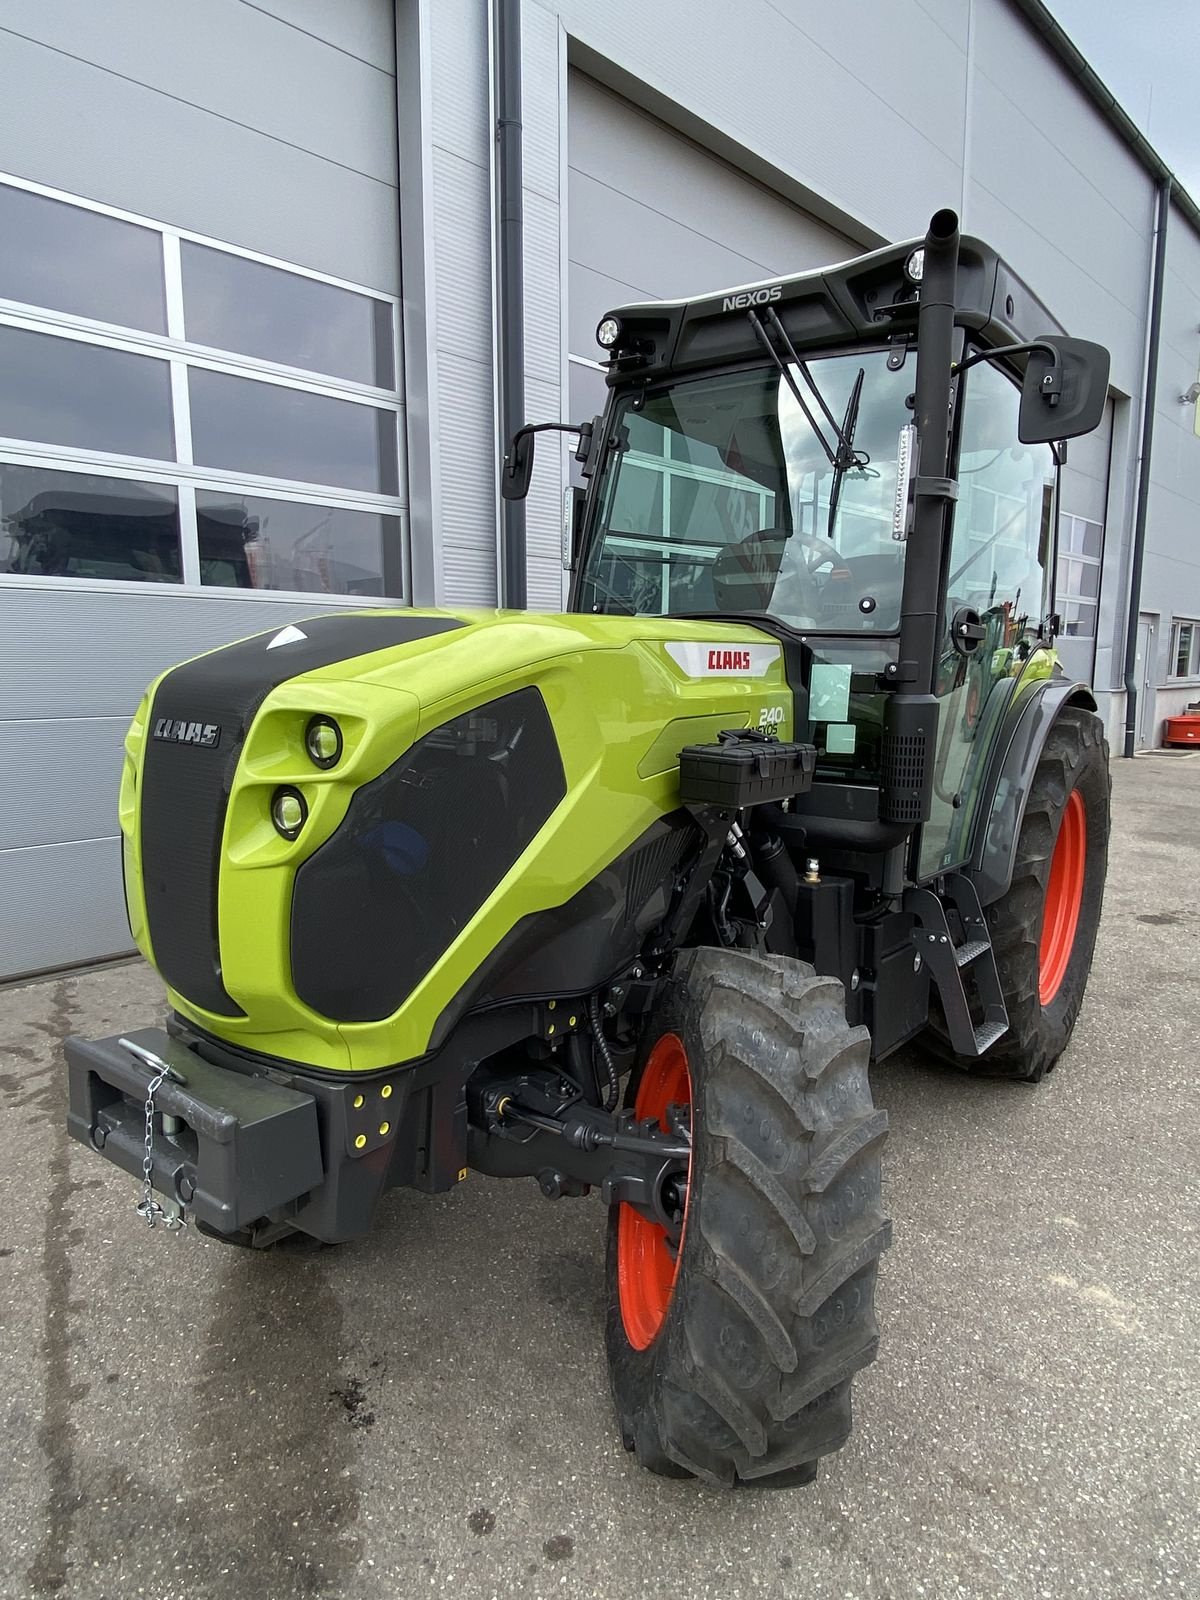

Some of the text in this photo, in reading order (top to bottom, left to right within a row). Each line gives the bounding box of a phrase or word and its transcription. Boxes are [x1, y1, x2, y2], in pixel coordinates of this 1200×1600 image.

[722, 286, 782, 312] NEXOS
[708, 650, 750, 670] CLAAS
[153, 718, 218, 745] CLAAS
[752, 723, 778, 736] EXOS
